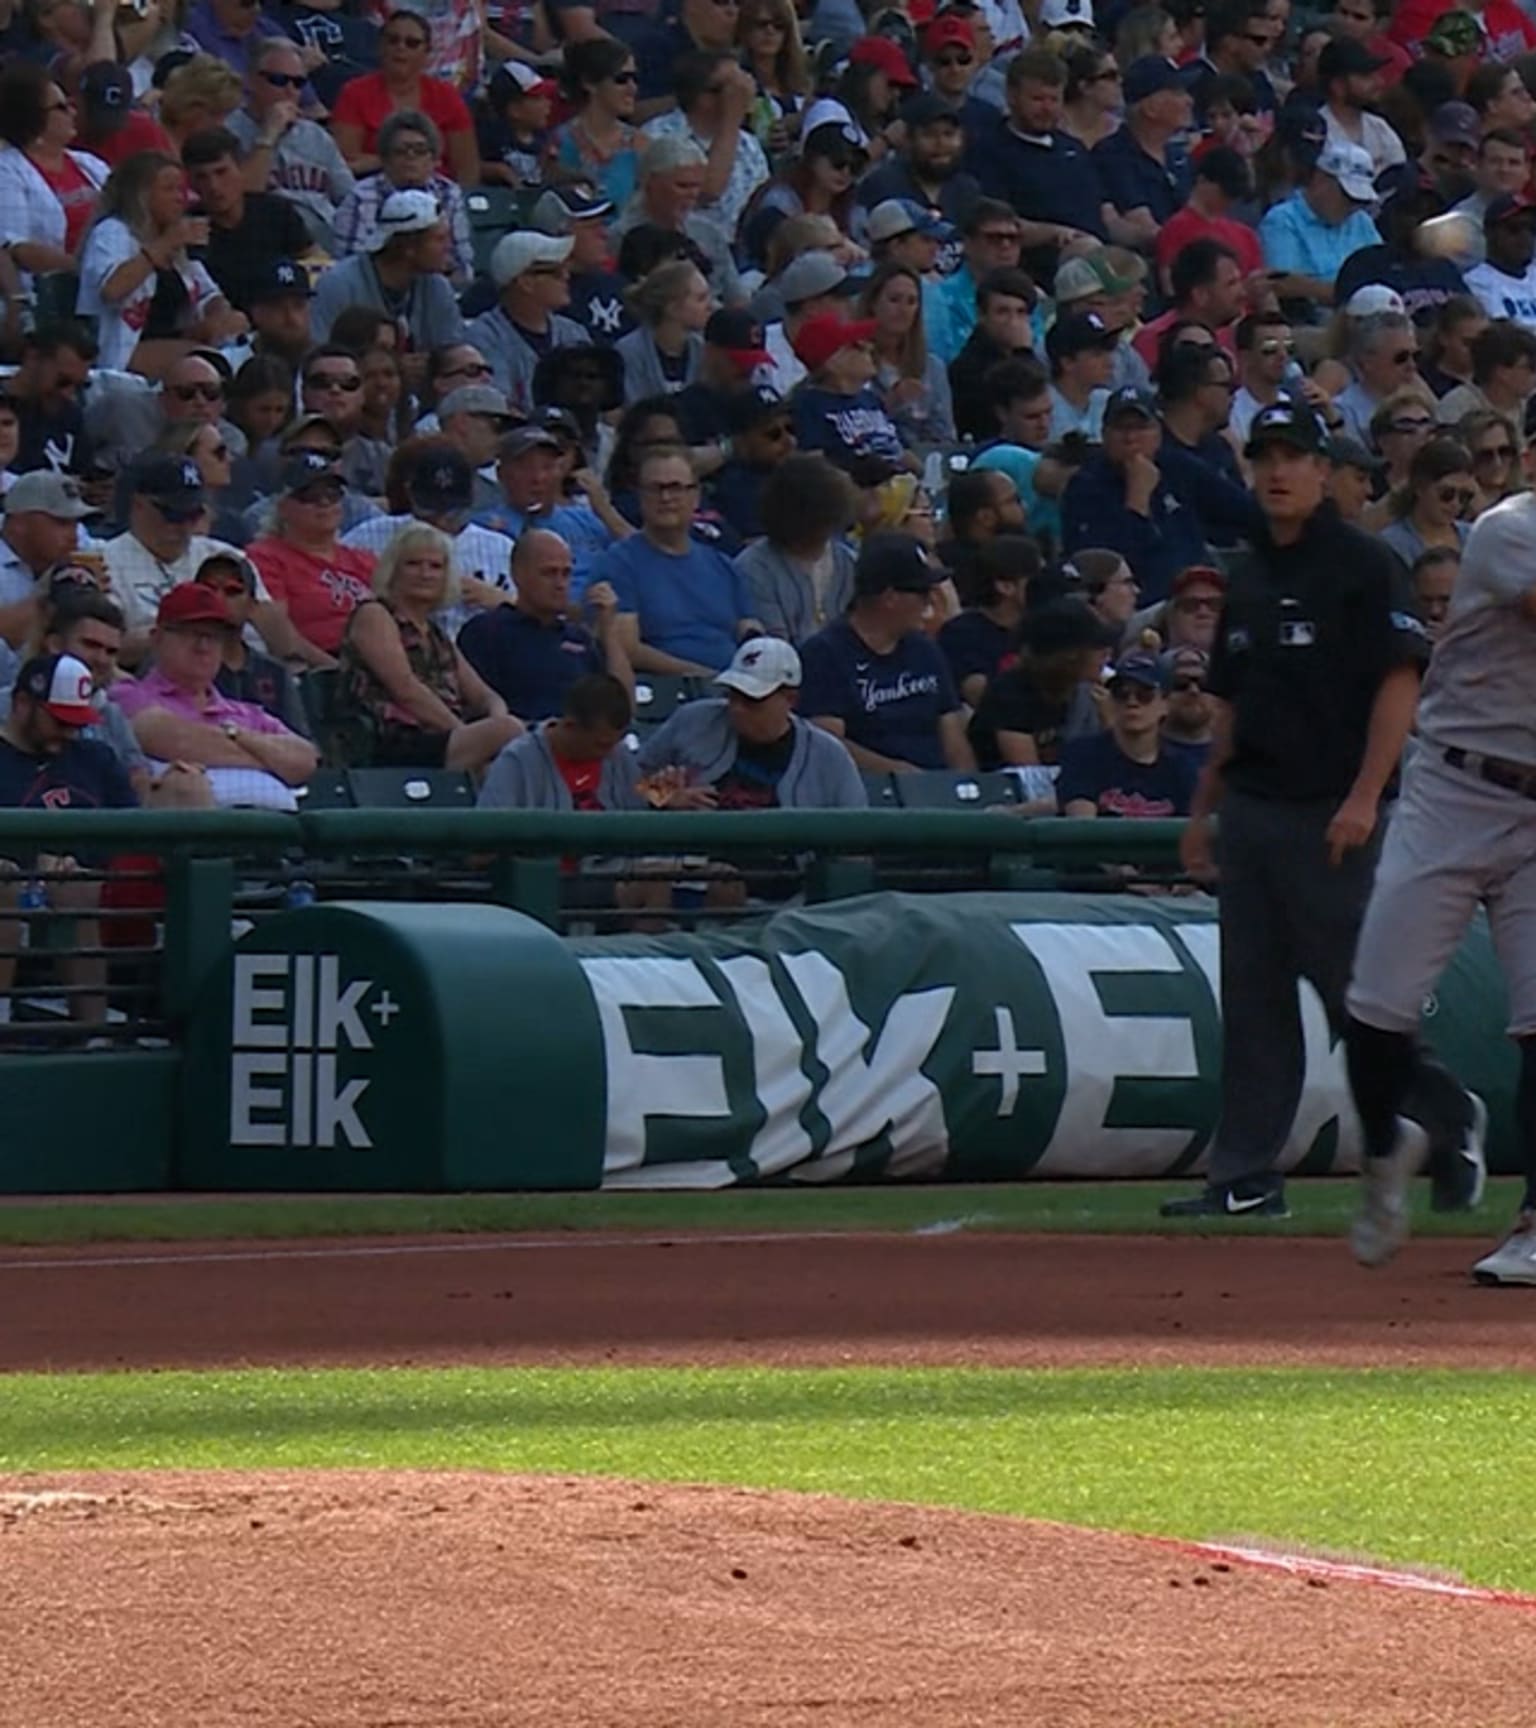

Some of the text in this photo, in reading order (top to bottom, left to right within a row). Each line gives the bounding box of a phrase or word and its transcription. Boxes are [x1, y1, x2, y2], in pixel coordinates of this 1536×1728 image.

[588, 295, 624, 333] NY
[856, 671, 938, 712] Yankees
[229, 1052, 374, 1148] Elk
